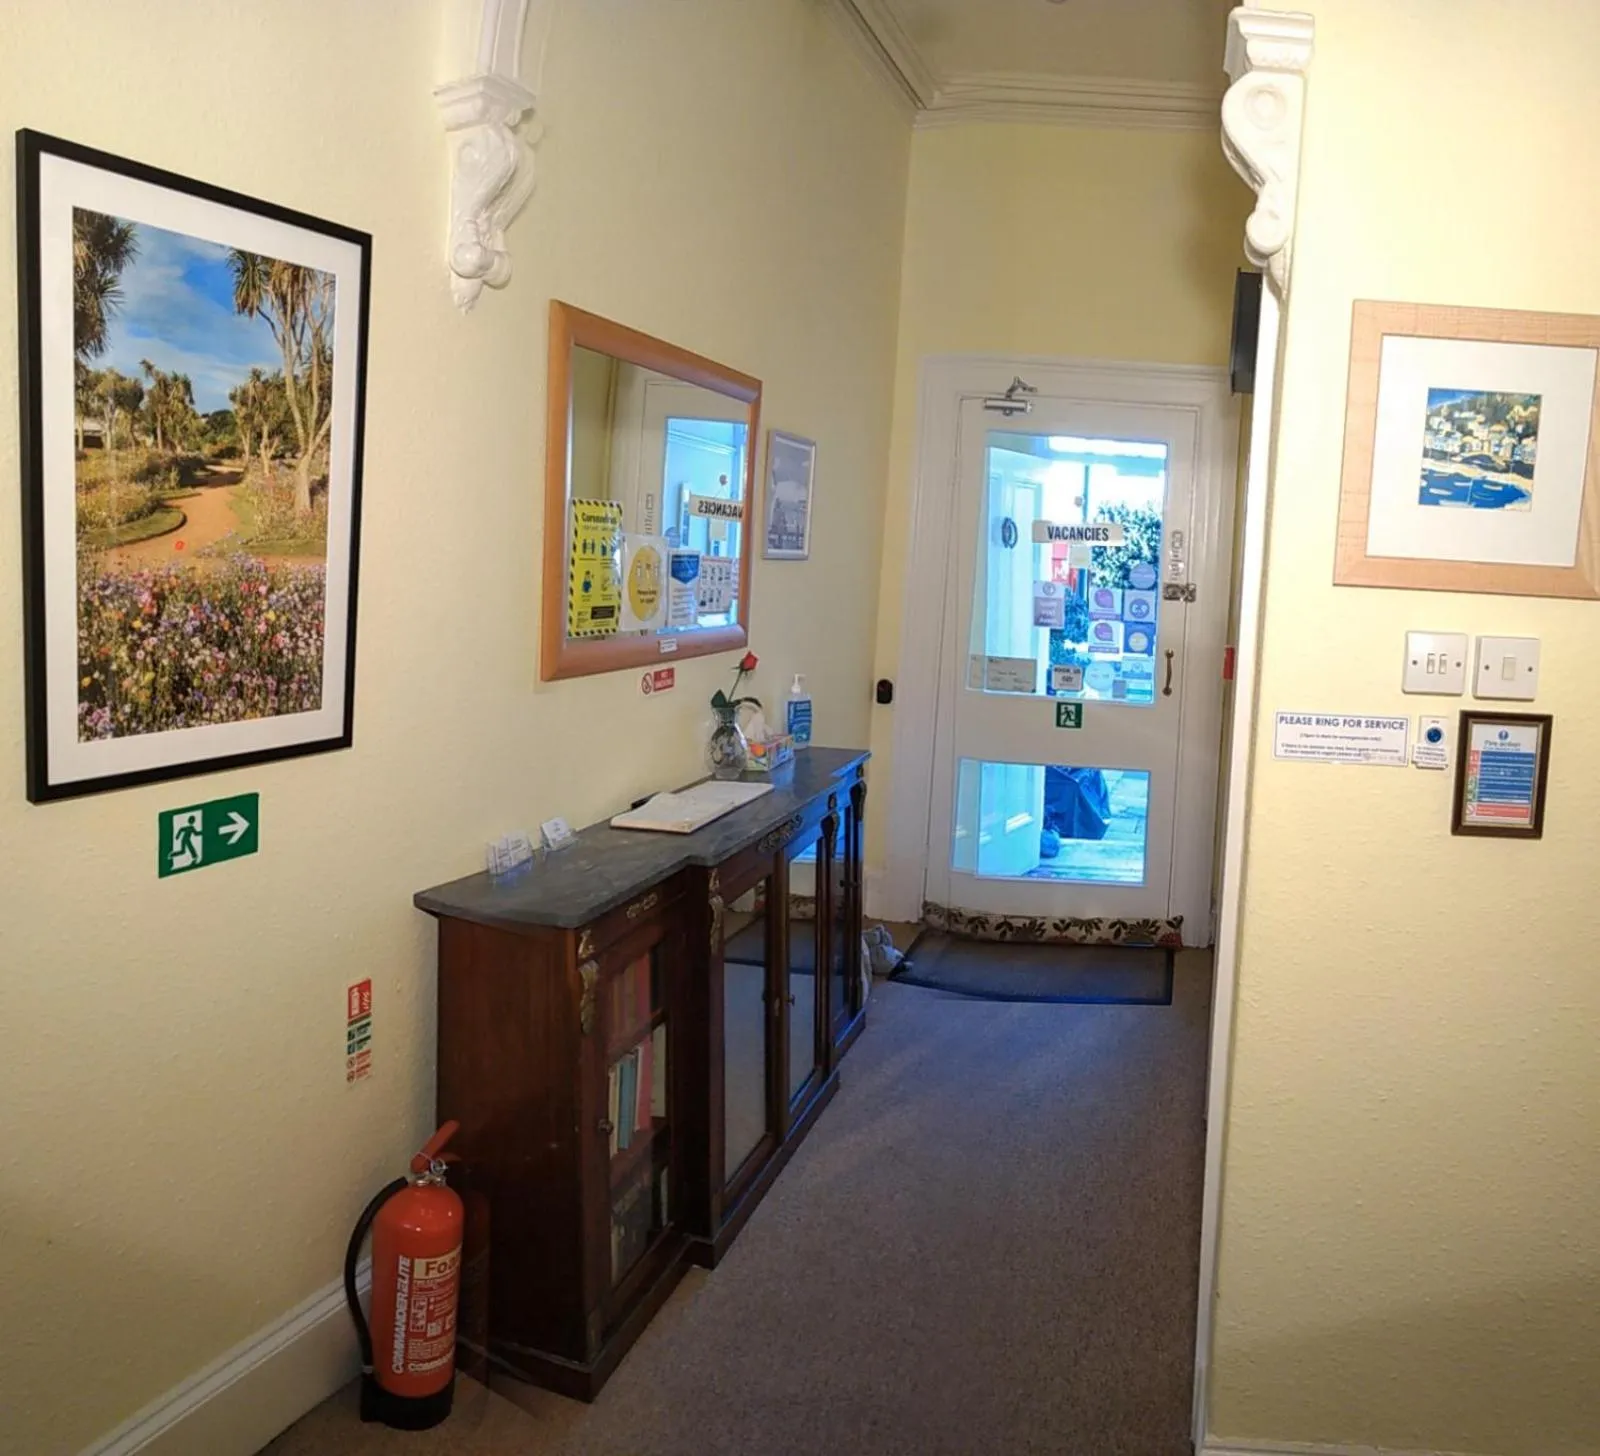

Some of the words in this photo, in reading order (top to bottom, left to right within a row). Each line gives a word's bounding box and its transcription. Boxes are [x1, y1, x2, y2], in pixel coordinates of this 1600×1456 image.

[1047, 526, 1109, 542] VACANCIES
[1279, 715, 1313, 726] PLEASE
[1315, 717, 1340, 728] RING
[1343, 718, 1362, 729] FOR
[1364, 720, 1405, 731] SERVICE
